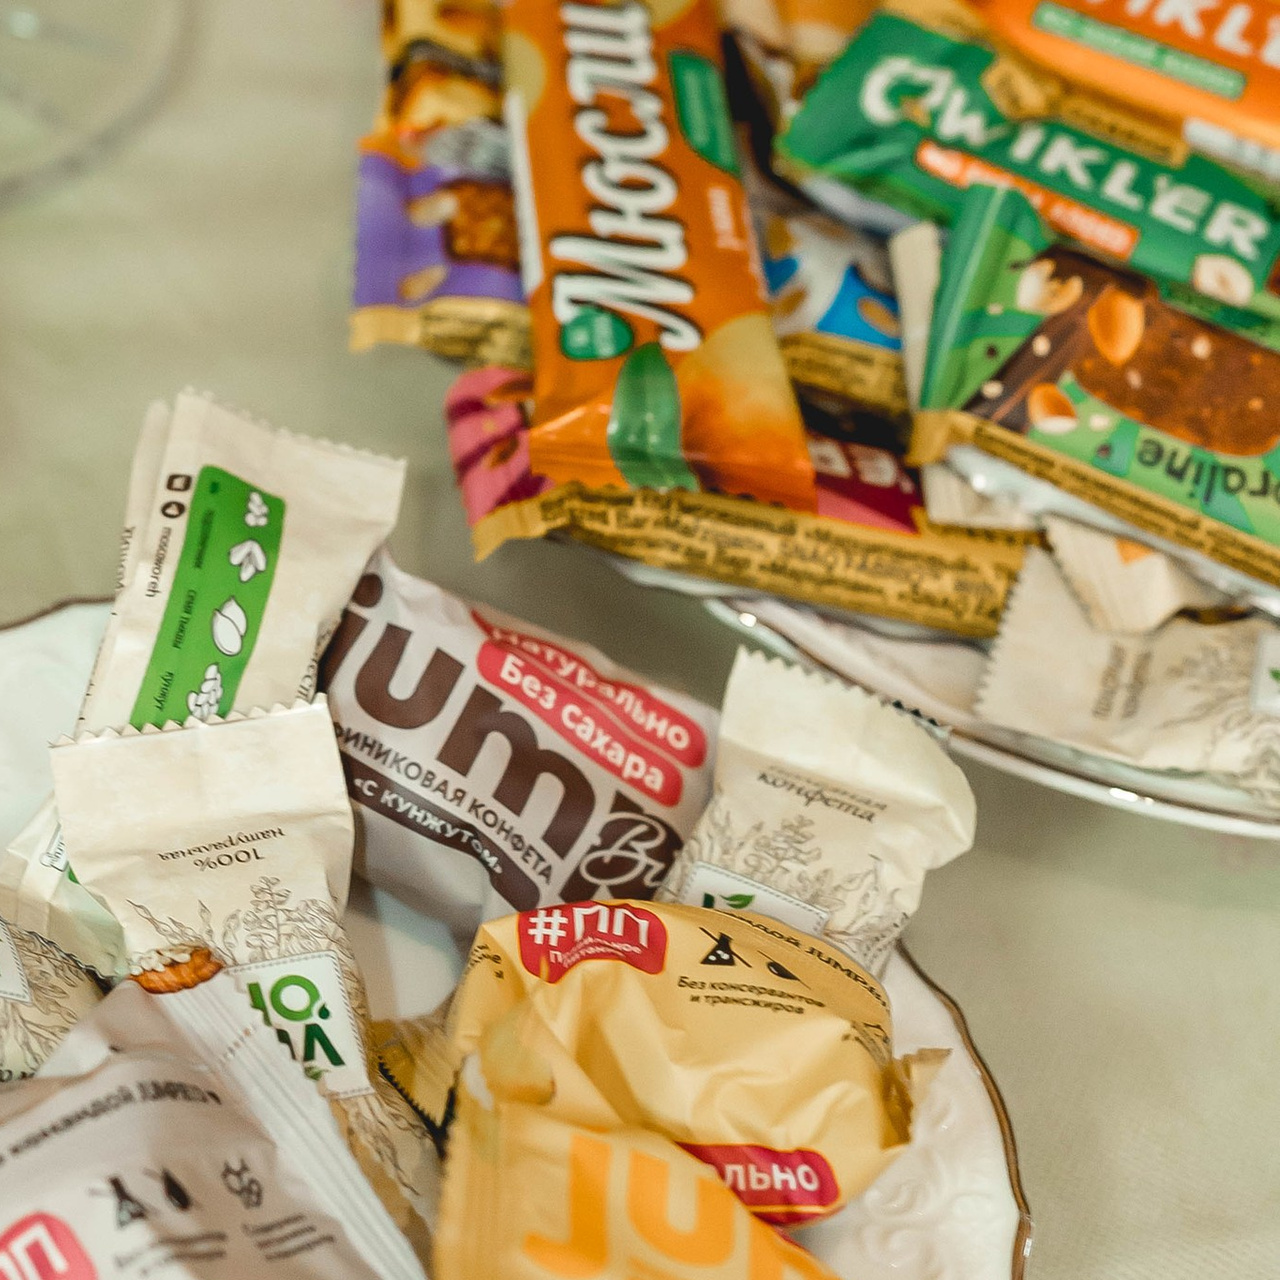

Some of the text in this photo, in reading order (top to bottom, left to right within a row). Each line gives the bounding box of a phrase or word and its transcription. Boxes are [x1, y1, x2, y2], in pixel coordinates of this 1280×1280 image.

[1136, 437, 1280, 506] raline
[499, 652, 666, 793] Без сахара
[193, 847, 266, 872] 100%
[468, 797, 554, 886] КОНФЕТА
